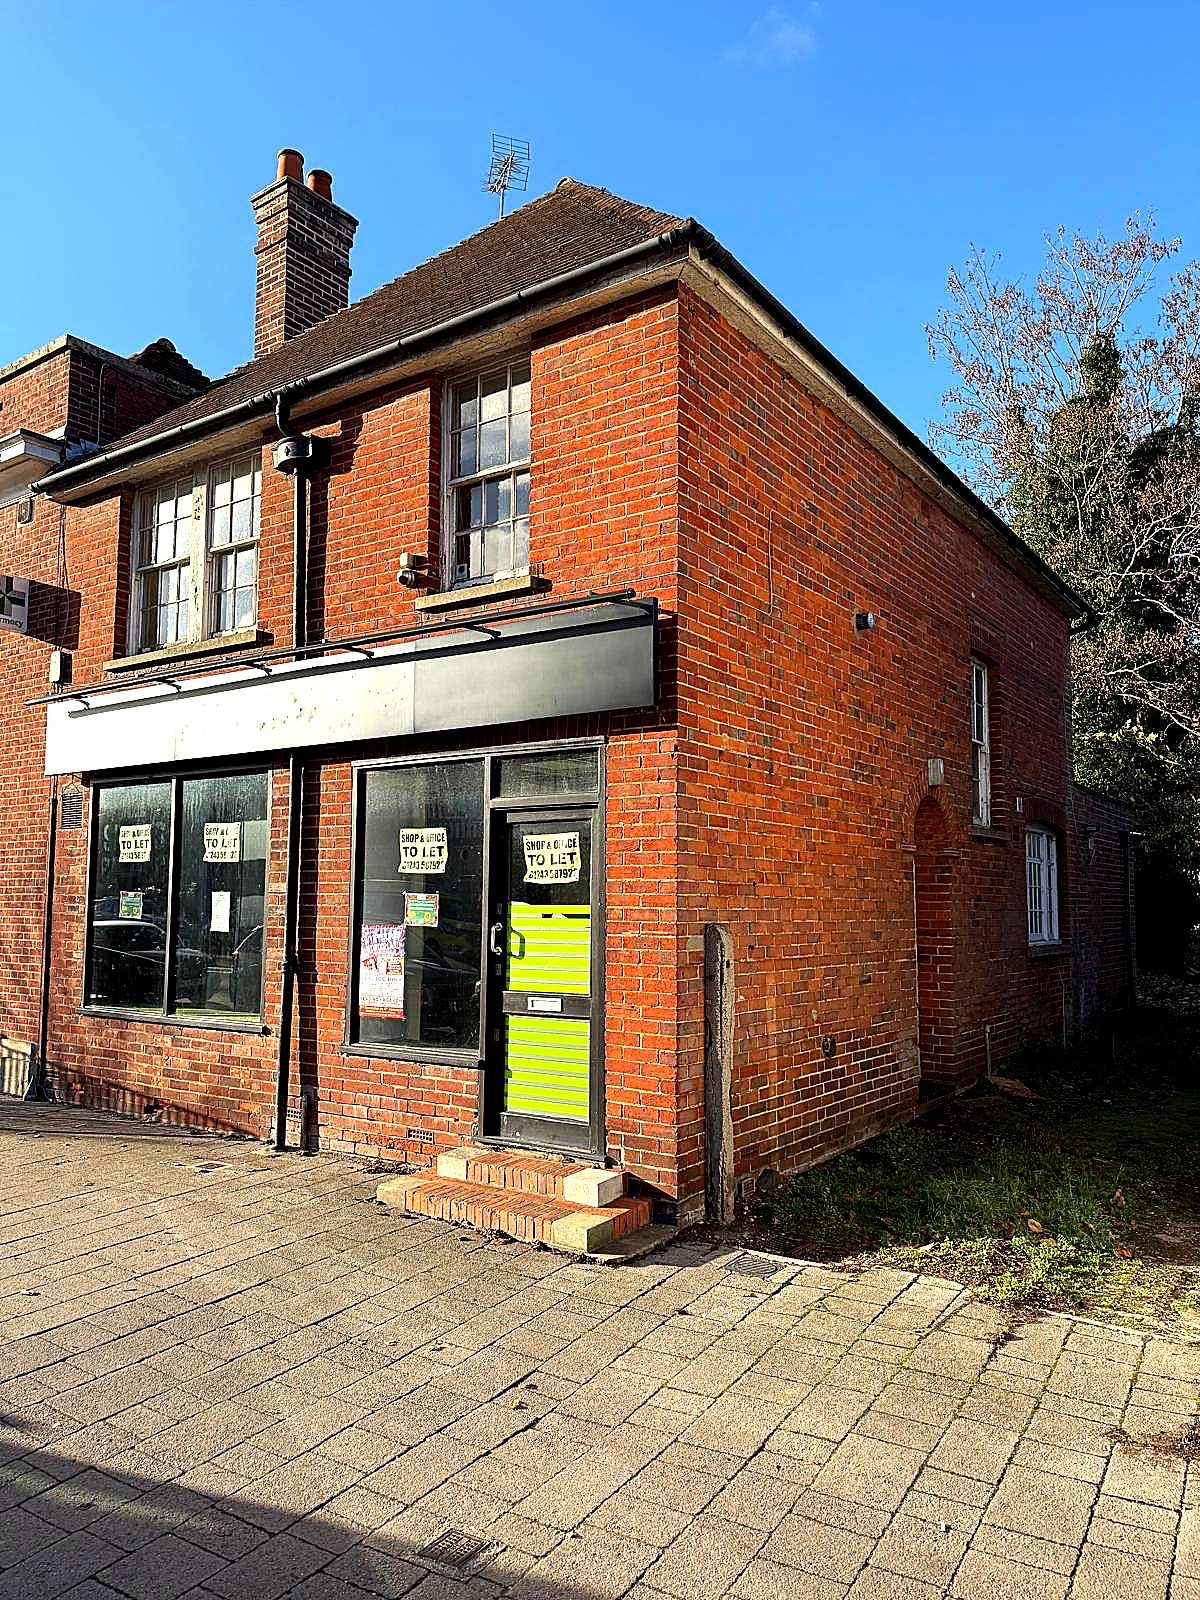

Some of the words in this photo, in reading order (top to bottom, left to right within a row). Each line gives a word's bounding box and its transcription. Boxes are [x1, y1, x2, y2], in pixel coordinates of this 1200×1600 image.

[206, 838, 219, 849] TO
[401, 833, 419, 843] SHOP
[121, 840, 132, 850] TO
[134, 839, 150, 849] LET
[525, 840, 546, 851] SHOP
[402, 846, 418, 858] TO
[422, 845, 445, 858] LET
[527, 853, 545, 867] TO
[550, 851, 577, 866] LET
